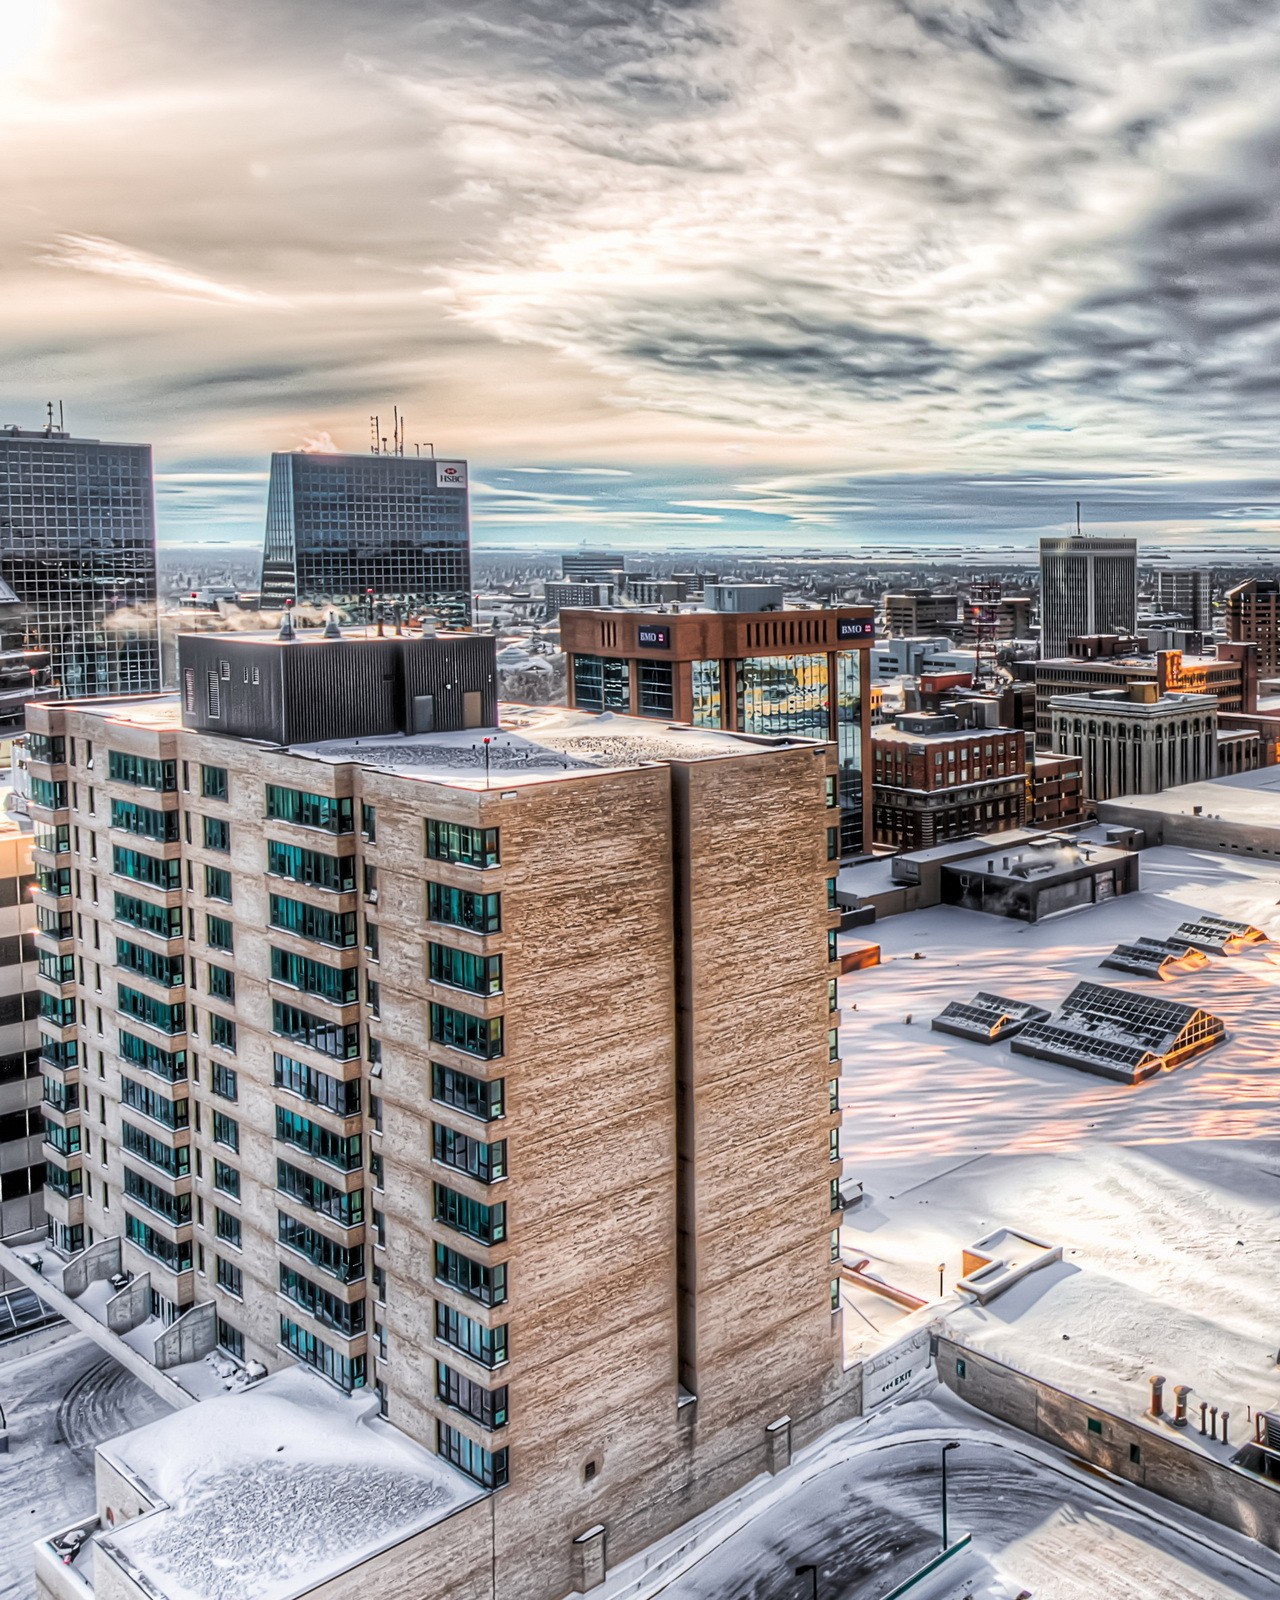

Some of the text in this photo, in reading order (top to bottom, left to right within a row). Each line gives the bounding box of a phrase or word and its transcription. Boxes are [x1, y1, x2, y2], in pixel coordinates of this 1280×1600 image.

[440, 475, 464, 483] HSBC
[841, 625, 862, 634] BMO
[640, 632, 656, 641] BMO
[895, 1369, 912, 1386] EXIT
